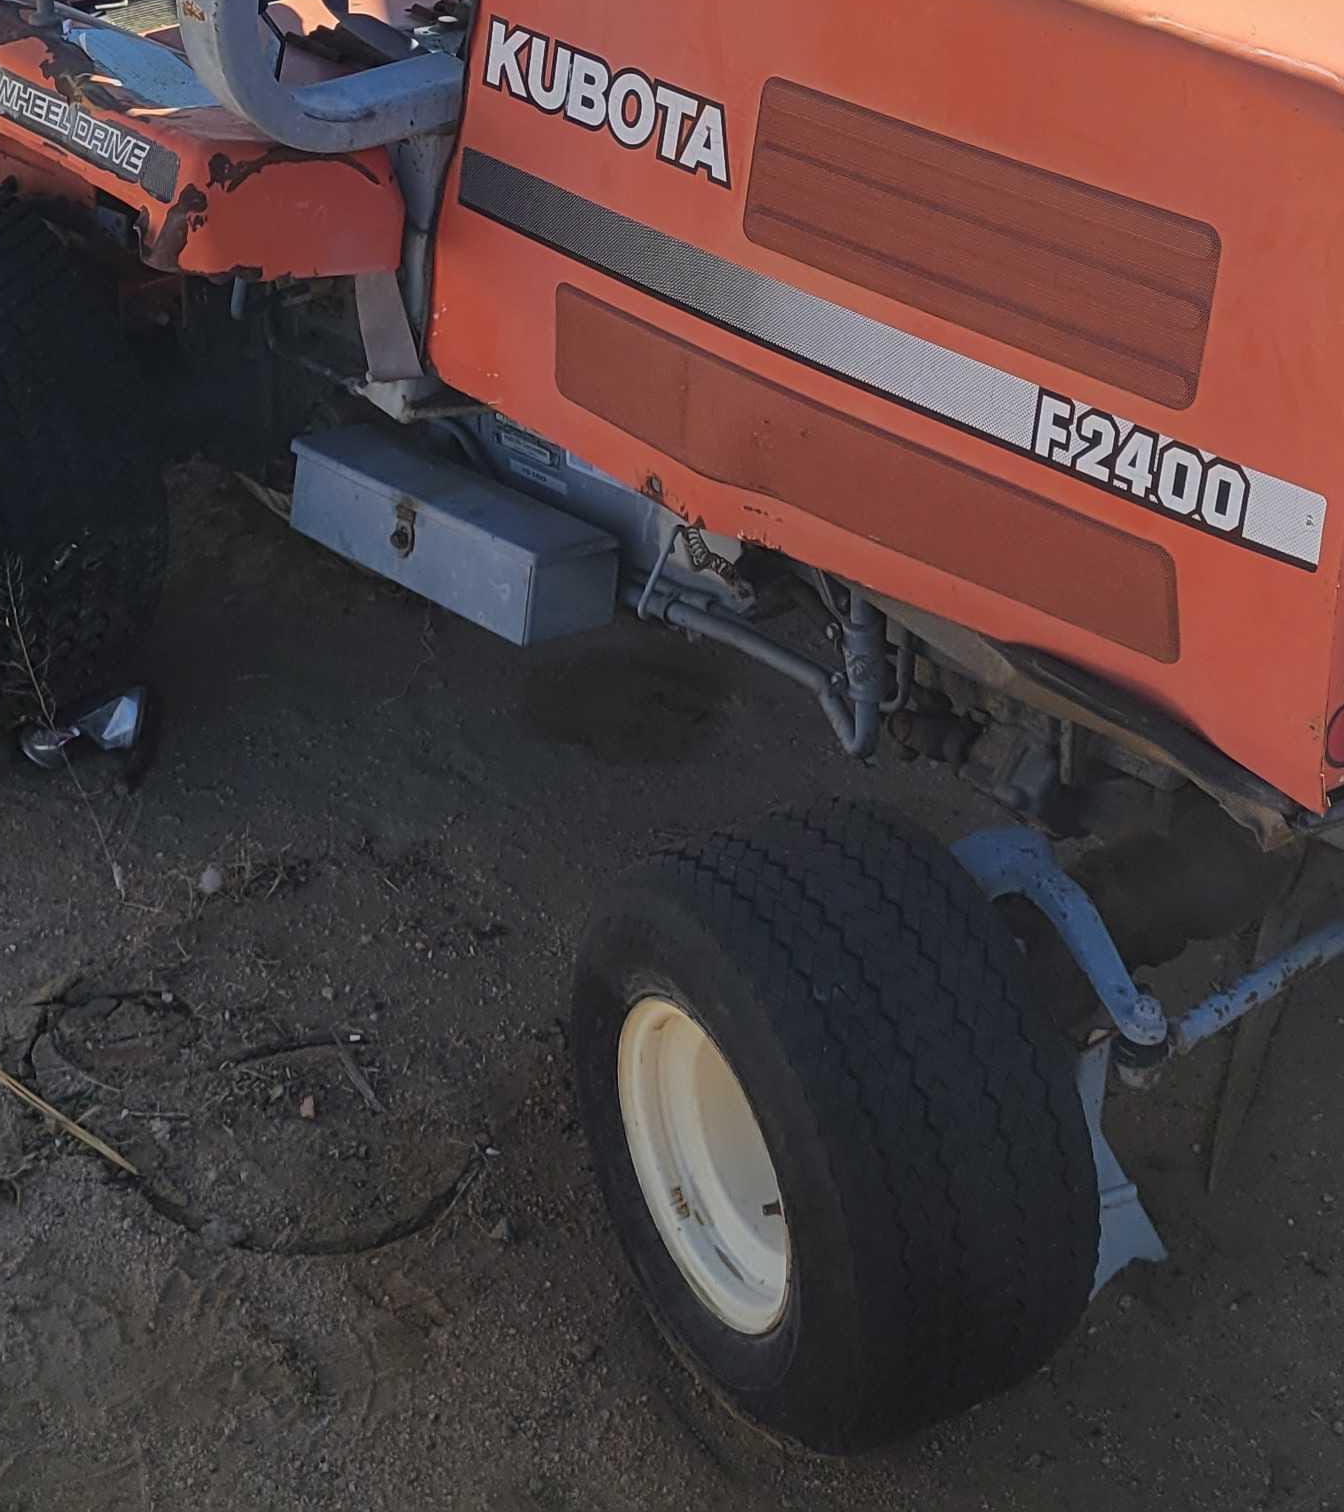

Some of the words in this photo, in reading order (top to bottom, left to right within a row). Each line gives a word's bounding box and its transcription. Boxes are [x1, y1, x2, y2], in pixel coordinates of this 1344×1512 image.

[71, 111, 150, 174] DRIVE
[484, 15, 731, 189] KUBOTA
[1032, 391, 1249, 534] F2400
